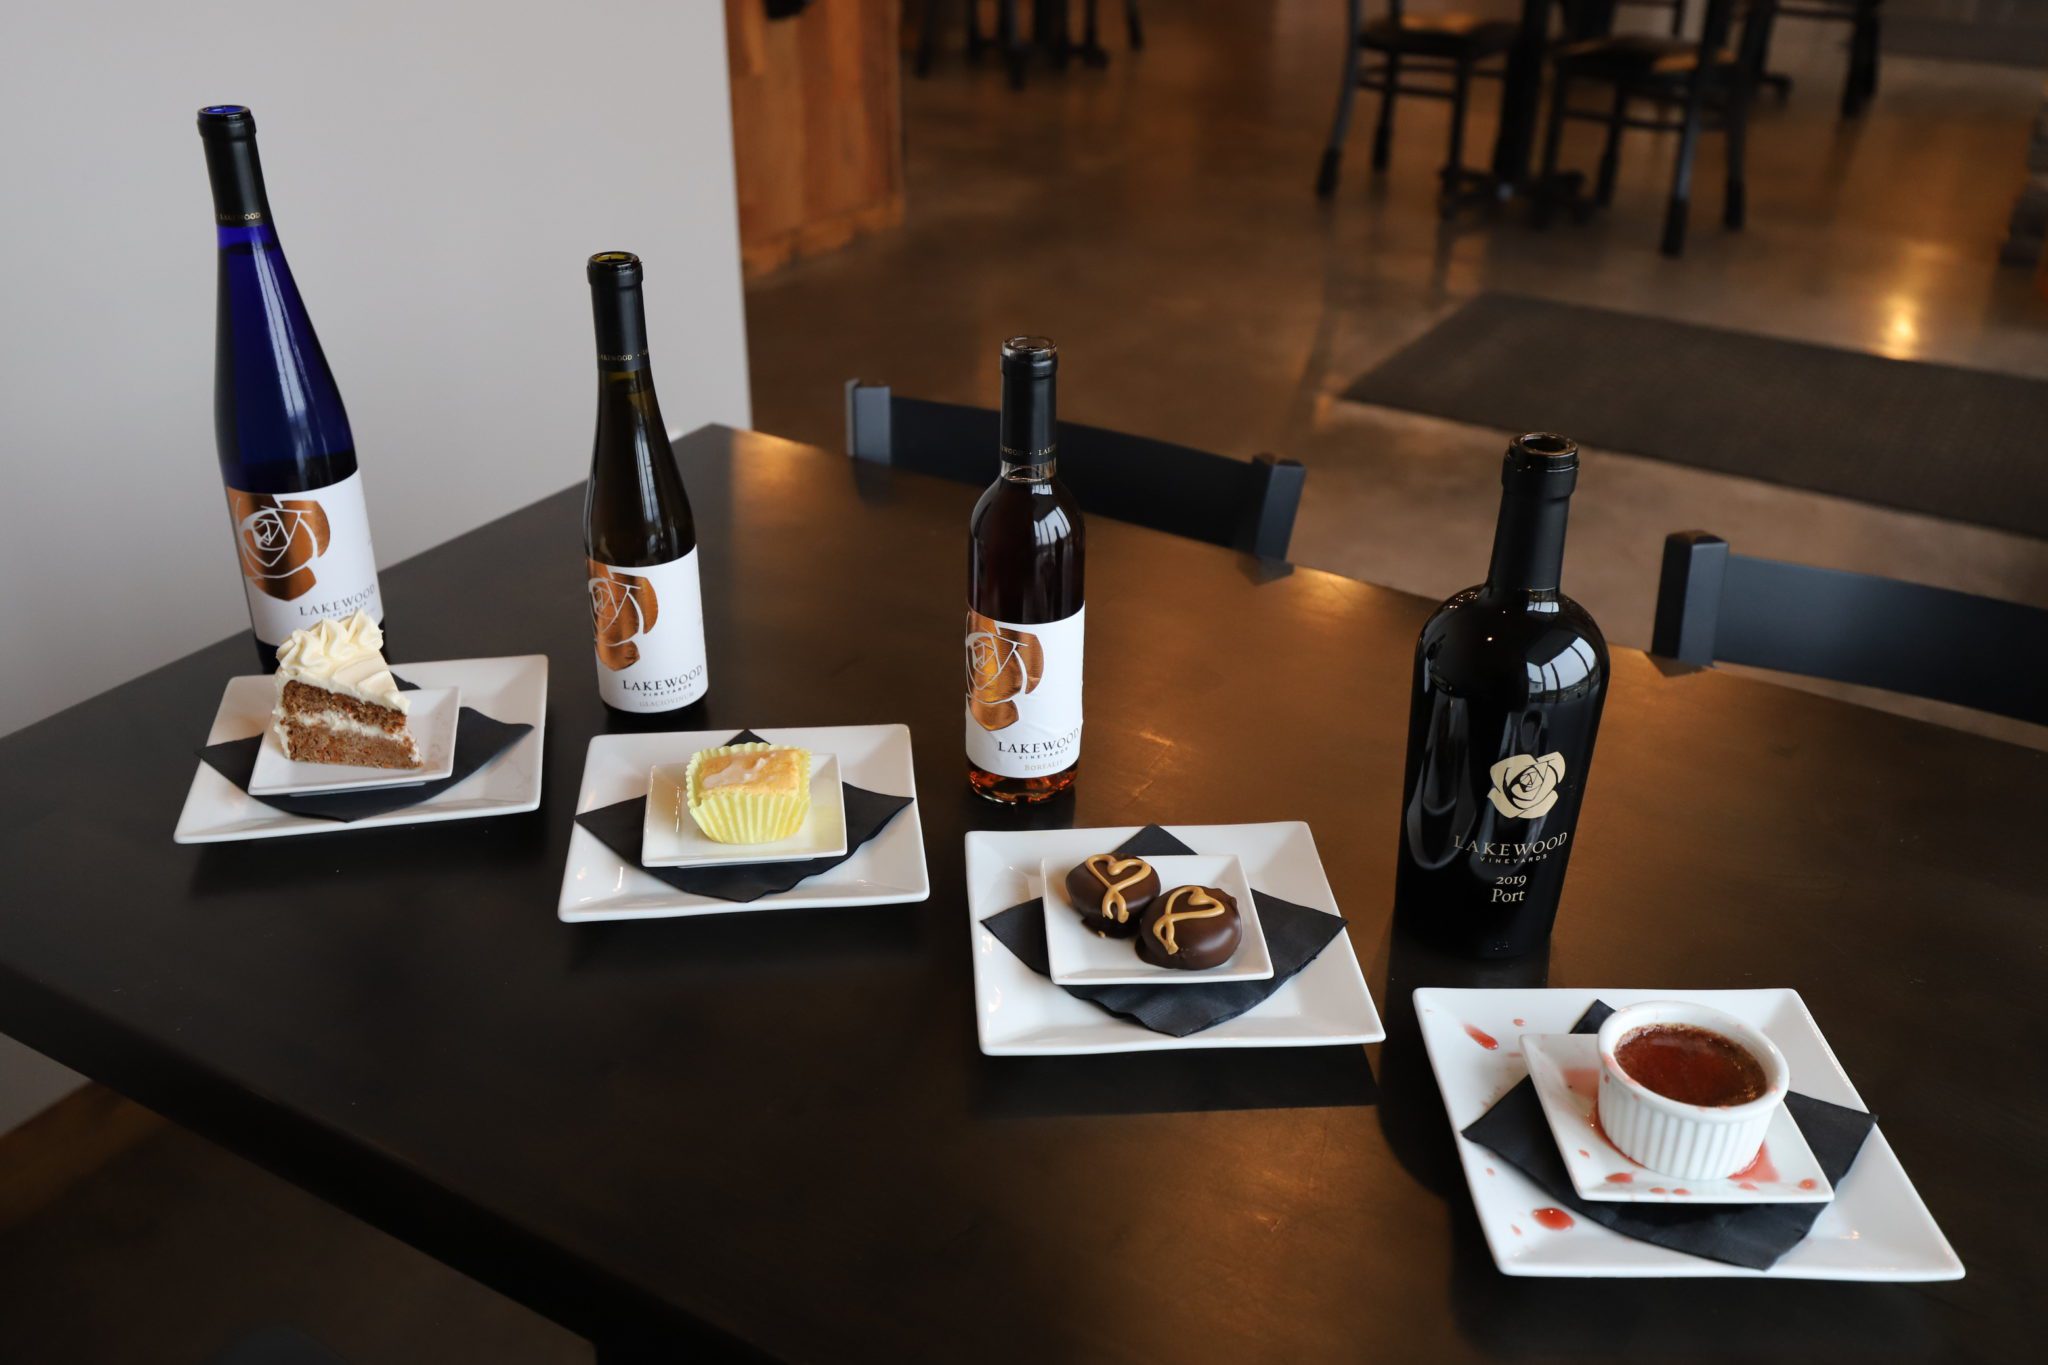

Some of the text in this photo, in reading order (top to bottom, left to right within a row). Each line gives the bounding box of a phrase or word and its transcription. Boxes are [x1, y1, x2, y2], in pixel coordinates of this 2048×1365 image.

[299, 584, 375, 616] LAKEWOOD
[623, 665, 702, 691] LAKEWOOD
[998, 728, 1079, 754] LAKEWOOD
[1455, 832, 1568, 856] LAKEWOOD
[1480, 854, 1547, 864] VINEYARDS
[1496, 875, 1527, 887] 2019
[1491, 888, 1525, 903] Port
